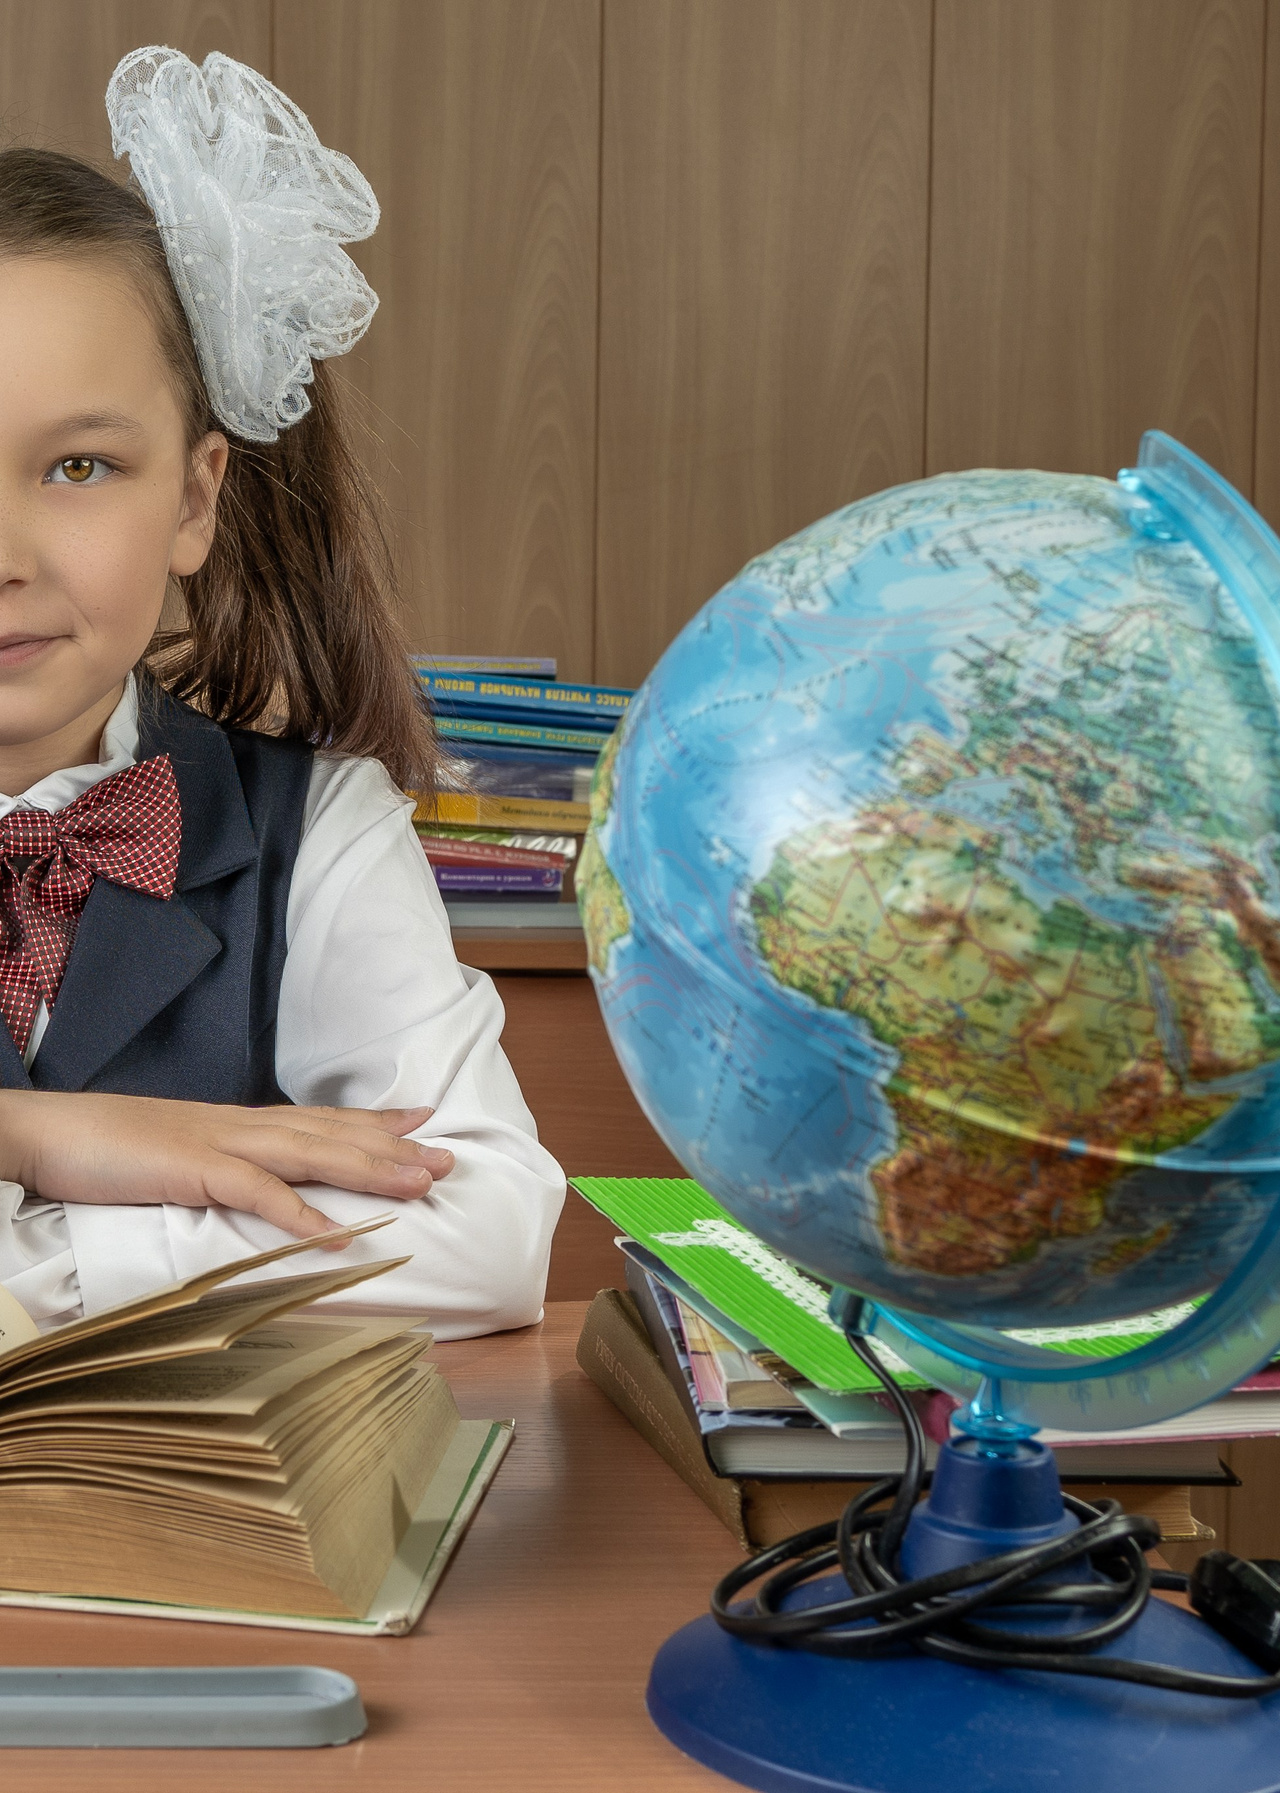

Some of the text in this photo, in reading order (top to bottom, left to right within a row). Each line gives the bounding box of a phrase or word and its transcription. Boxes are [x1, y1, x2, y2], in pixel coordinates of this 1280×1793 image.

[434, 678, 476, 694] ШКОЛЫ
[480, 682, 541, 699] НАЧАЛЬНОЙ
[545, 688, 591, 704] УЧИТЕЛЯ
